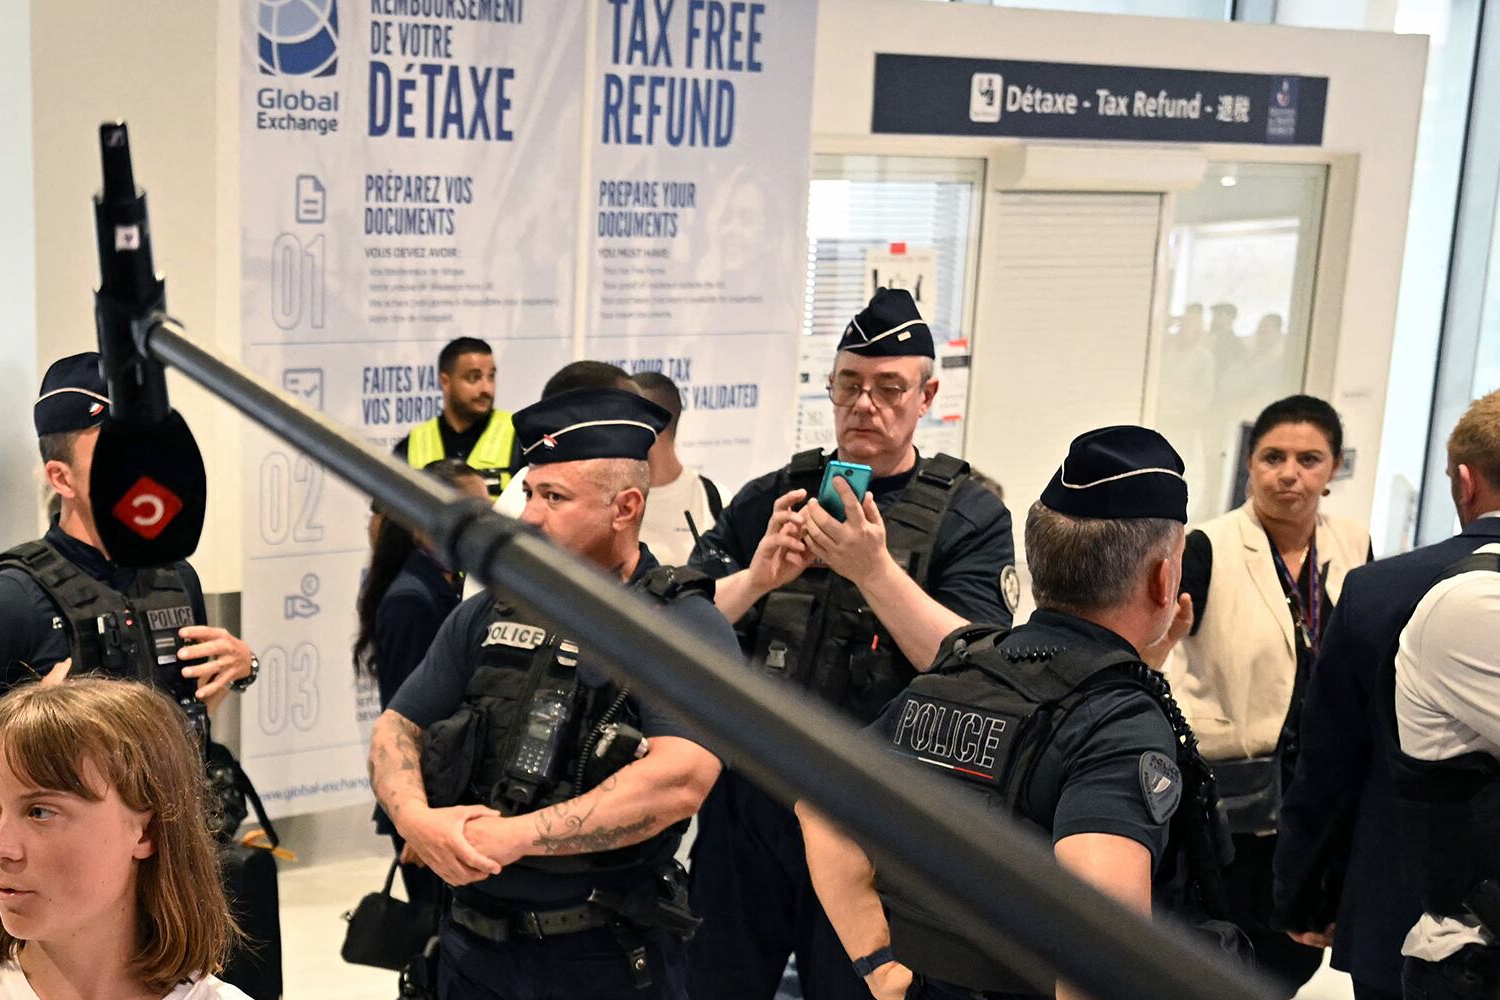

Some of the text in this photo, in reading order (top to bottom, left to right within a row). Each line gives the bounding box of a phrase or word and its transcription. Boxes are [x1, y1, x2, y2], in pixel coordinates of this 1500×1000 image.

[370, 21, 453, 58] DE VOTRE
[608, 0, 765, 72] TAX FREE
[257, 88, 339, 112] Global
[603, 74, 735, 148] REFUND
[1005, 84, 1078, 115] Détaxe
[1096, 89, 1129, 116] Tax
[1133, 89, 1202, 120] Refund
[256, 112, 338, 135] Exchange
[365, 169, 473, 204] PRÉPAREZ VOS
[599, 181, 696, 208] PREPARE YOUR
[364, 207, 454, 235] DOCUMENTS
[597, 212, 678, 238] DOCUMENTS
[271, 232, 324, 331] 01
[363, 366, 412, 393] FAITES
[669, 358, 692, 381] TAX
[362, 396, 443, 425] VOS BORDE
[693, 384, 758, 410] VALIDATED
[260, 452, 325, 545] 02
[487, 624, 544, 646] OLICE
[259, 642, 320, 736] 03
[894, 699, 1006, 769] POLICE
